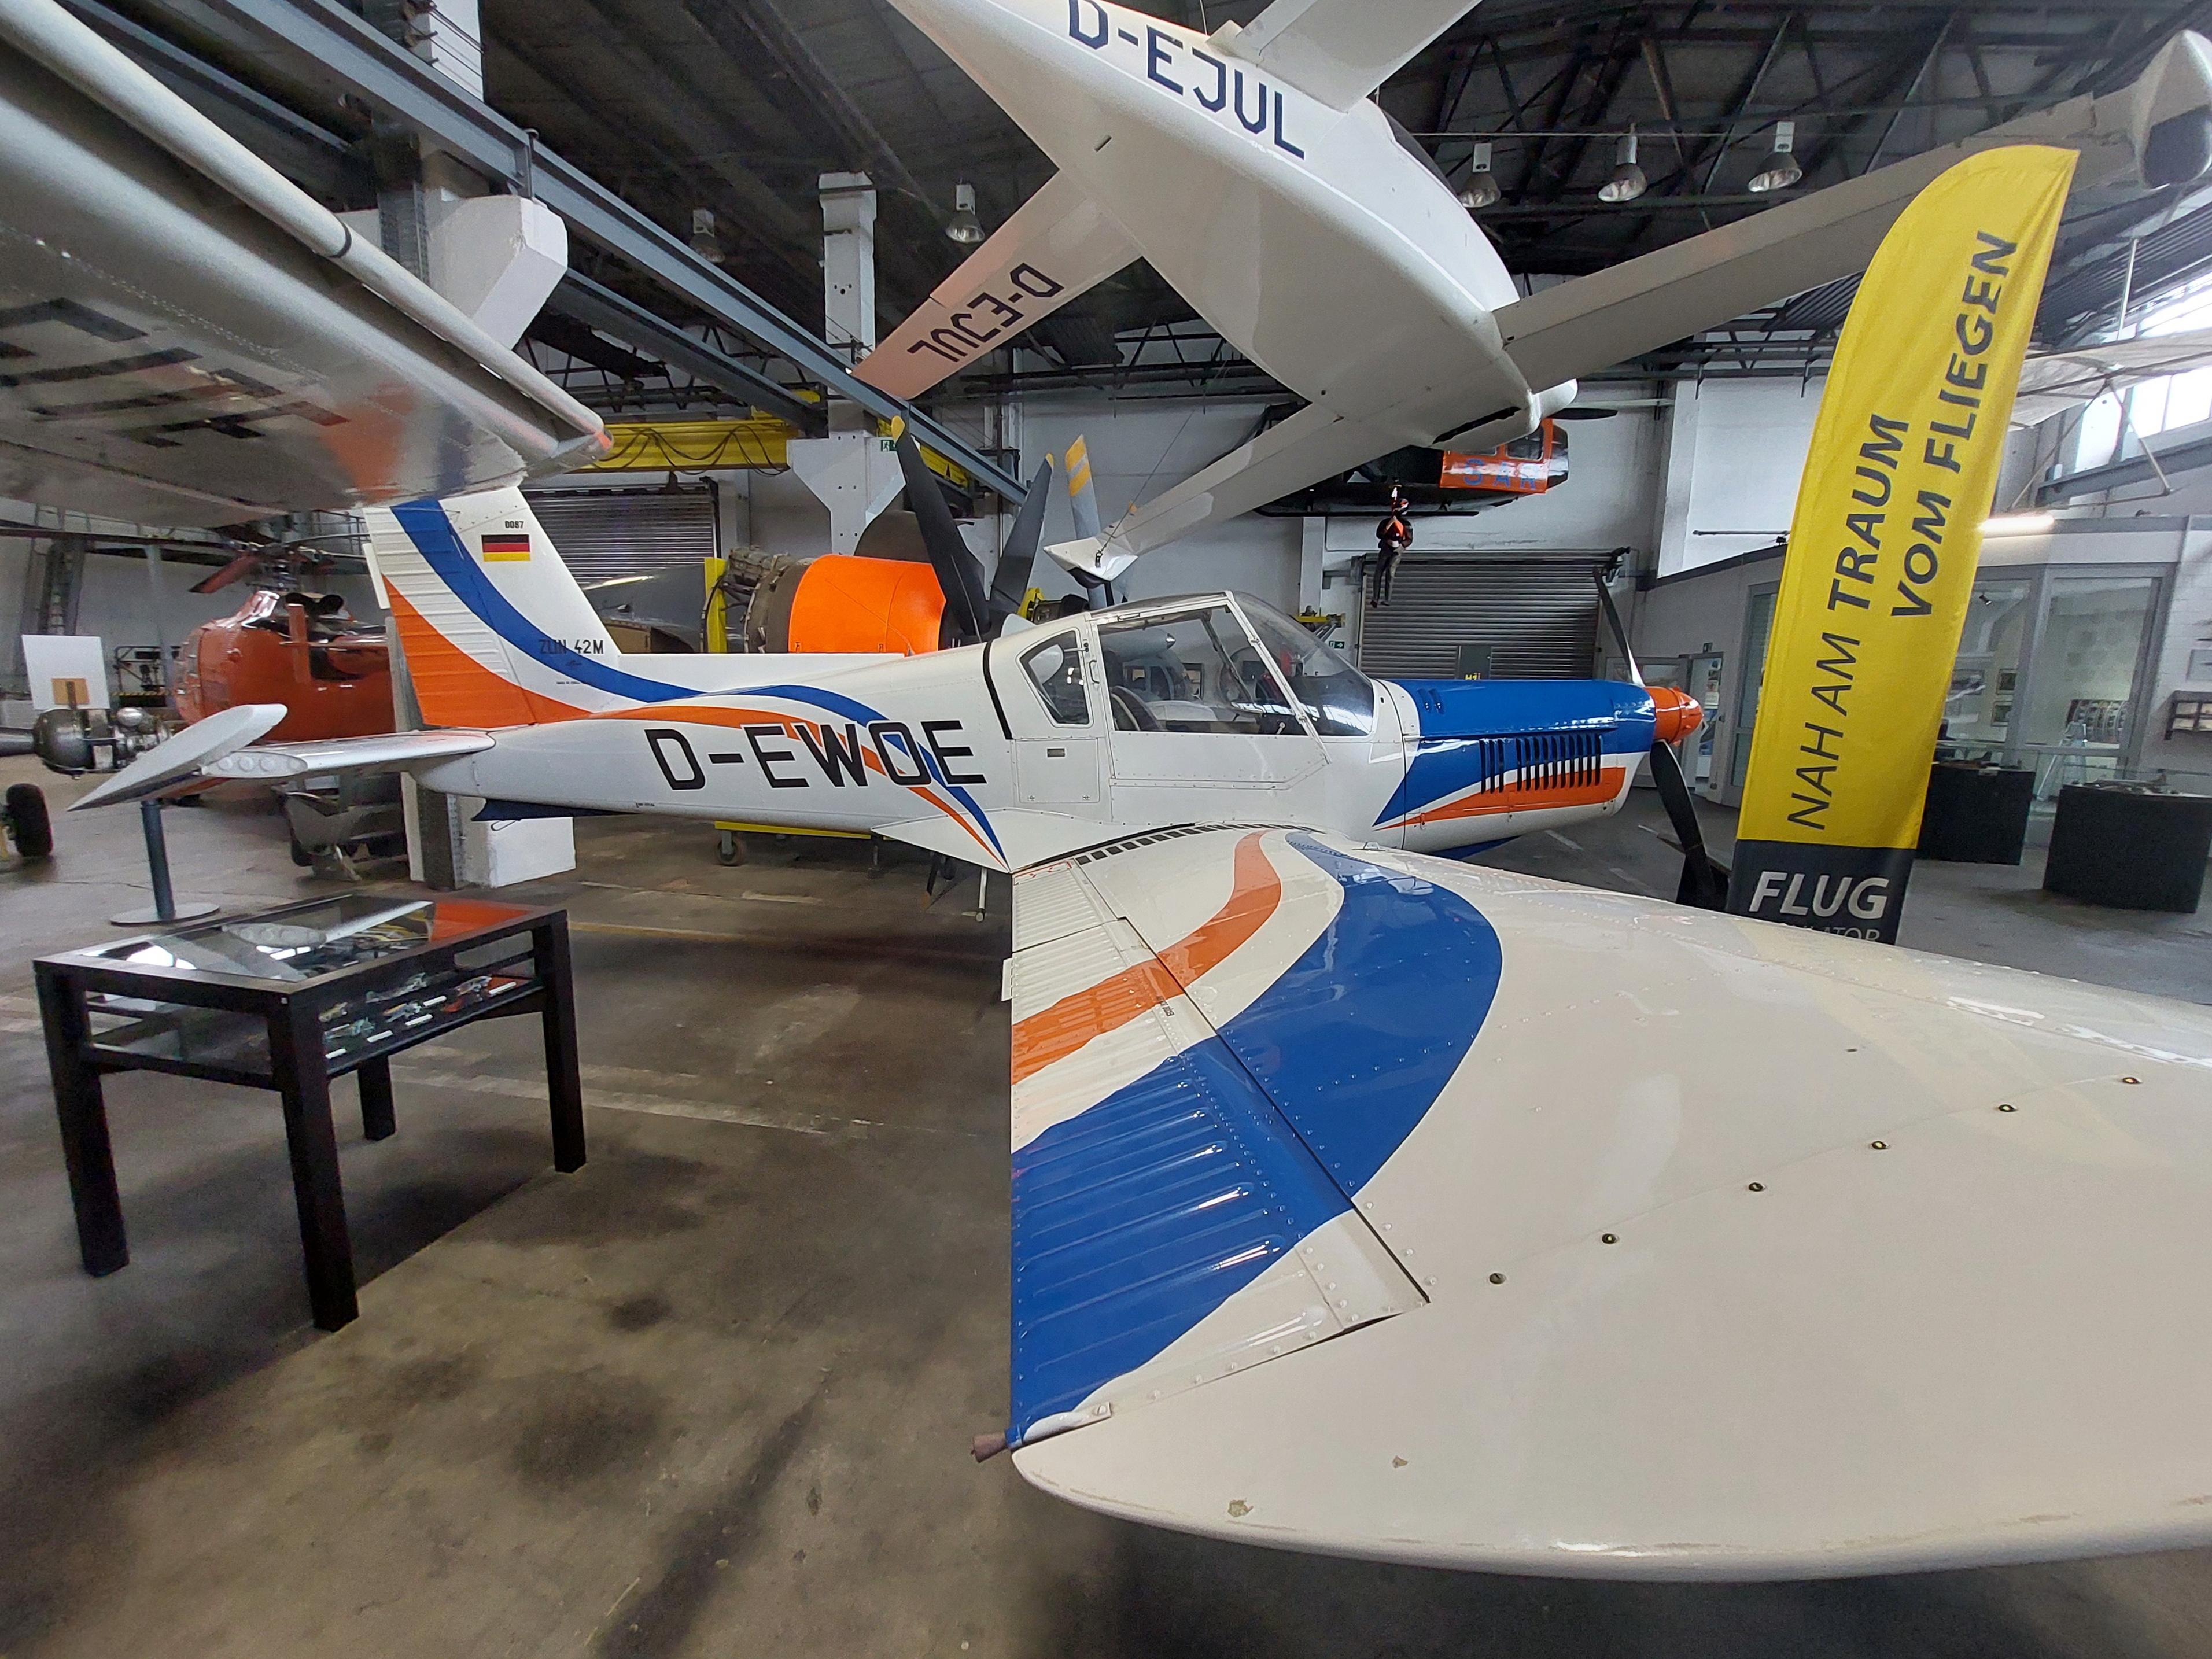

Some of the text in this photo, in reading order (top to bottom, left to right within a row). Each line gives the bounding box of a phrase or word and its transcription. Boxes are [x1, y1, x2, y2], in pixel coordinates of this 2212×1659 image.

[1068, 0, 1305, 160] D-EJUL
[906, 262, 1065, 363] D-EJUL
[1890, 230, 2018, 617] VOM FLIEGEN
[1787, 413, 1909, 831] NAH AM TRAUM
[644, 720, 988, 791] D-EWOE
[1748, 871, 1890, 920] FLUG
